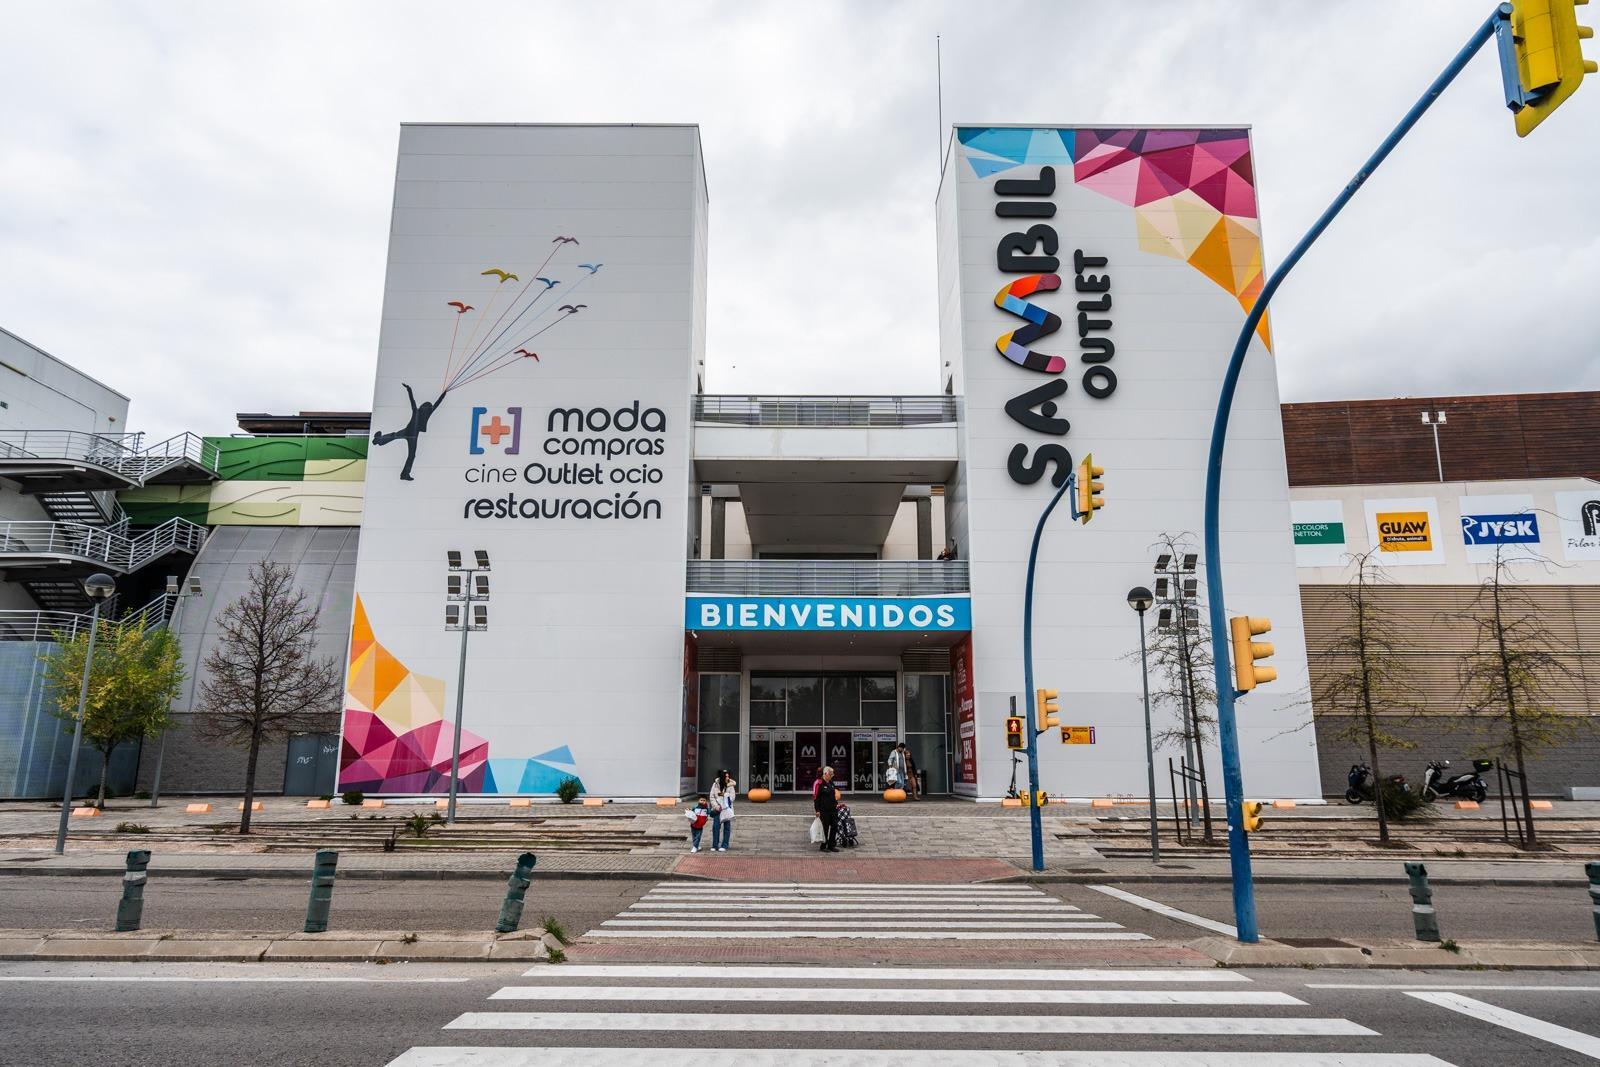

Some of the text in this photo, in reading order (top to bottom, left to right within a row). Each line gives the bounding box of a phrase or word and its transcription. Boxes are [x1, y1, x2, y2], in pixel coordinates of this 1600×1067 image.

[993, 165, 1073, 488] SAMBIL
[1074, 249, 1117, 399] OUTLET
[547, 400, 666, 432] moda
[543, 438, 664, 460] compras
[465, 463, 663, 484] cine Outlet ocio
[464, 491, 661, 519] restauración
[1379, 521, 1426, 534] GUAW
[1478, 520, 1536, 537] JYSK
[701, 603, 955, 627] BIENVENIDOS
